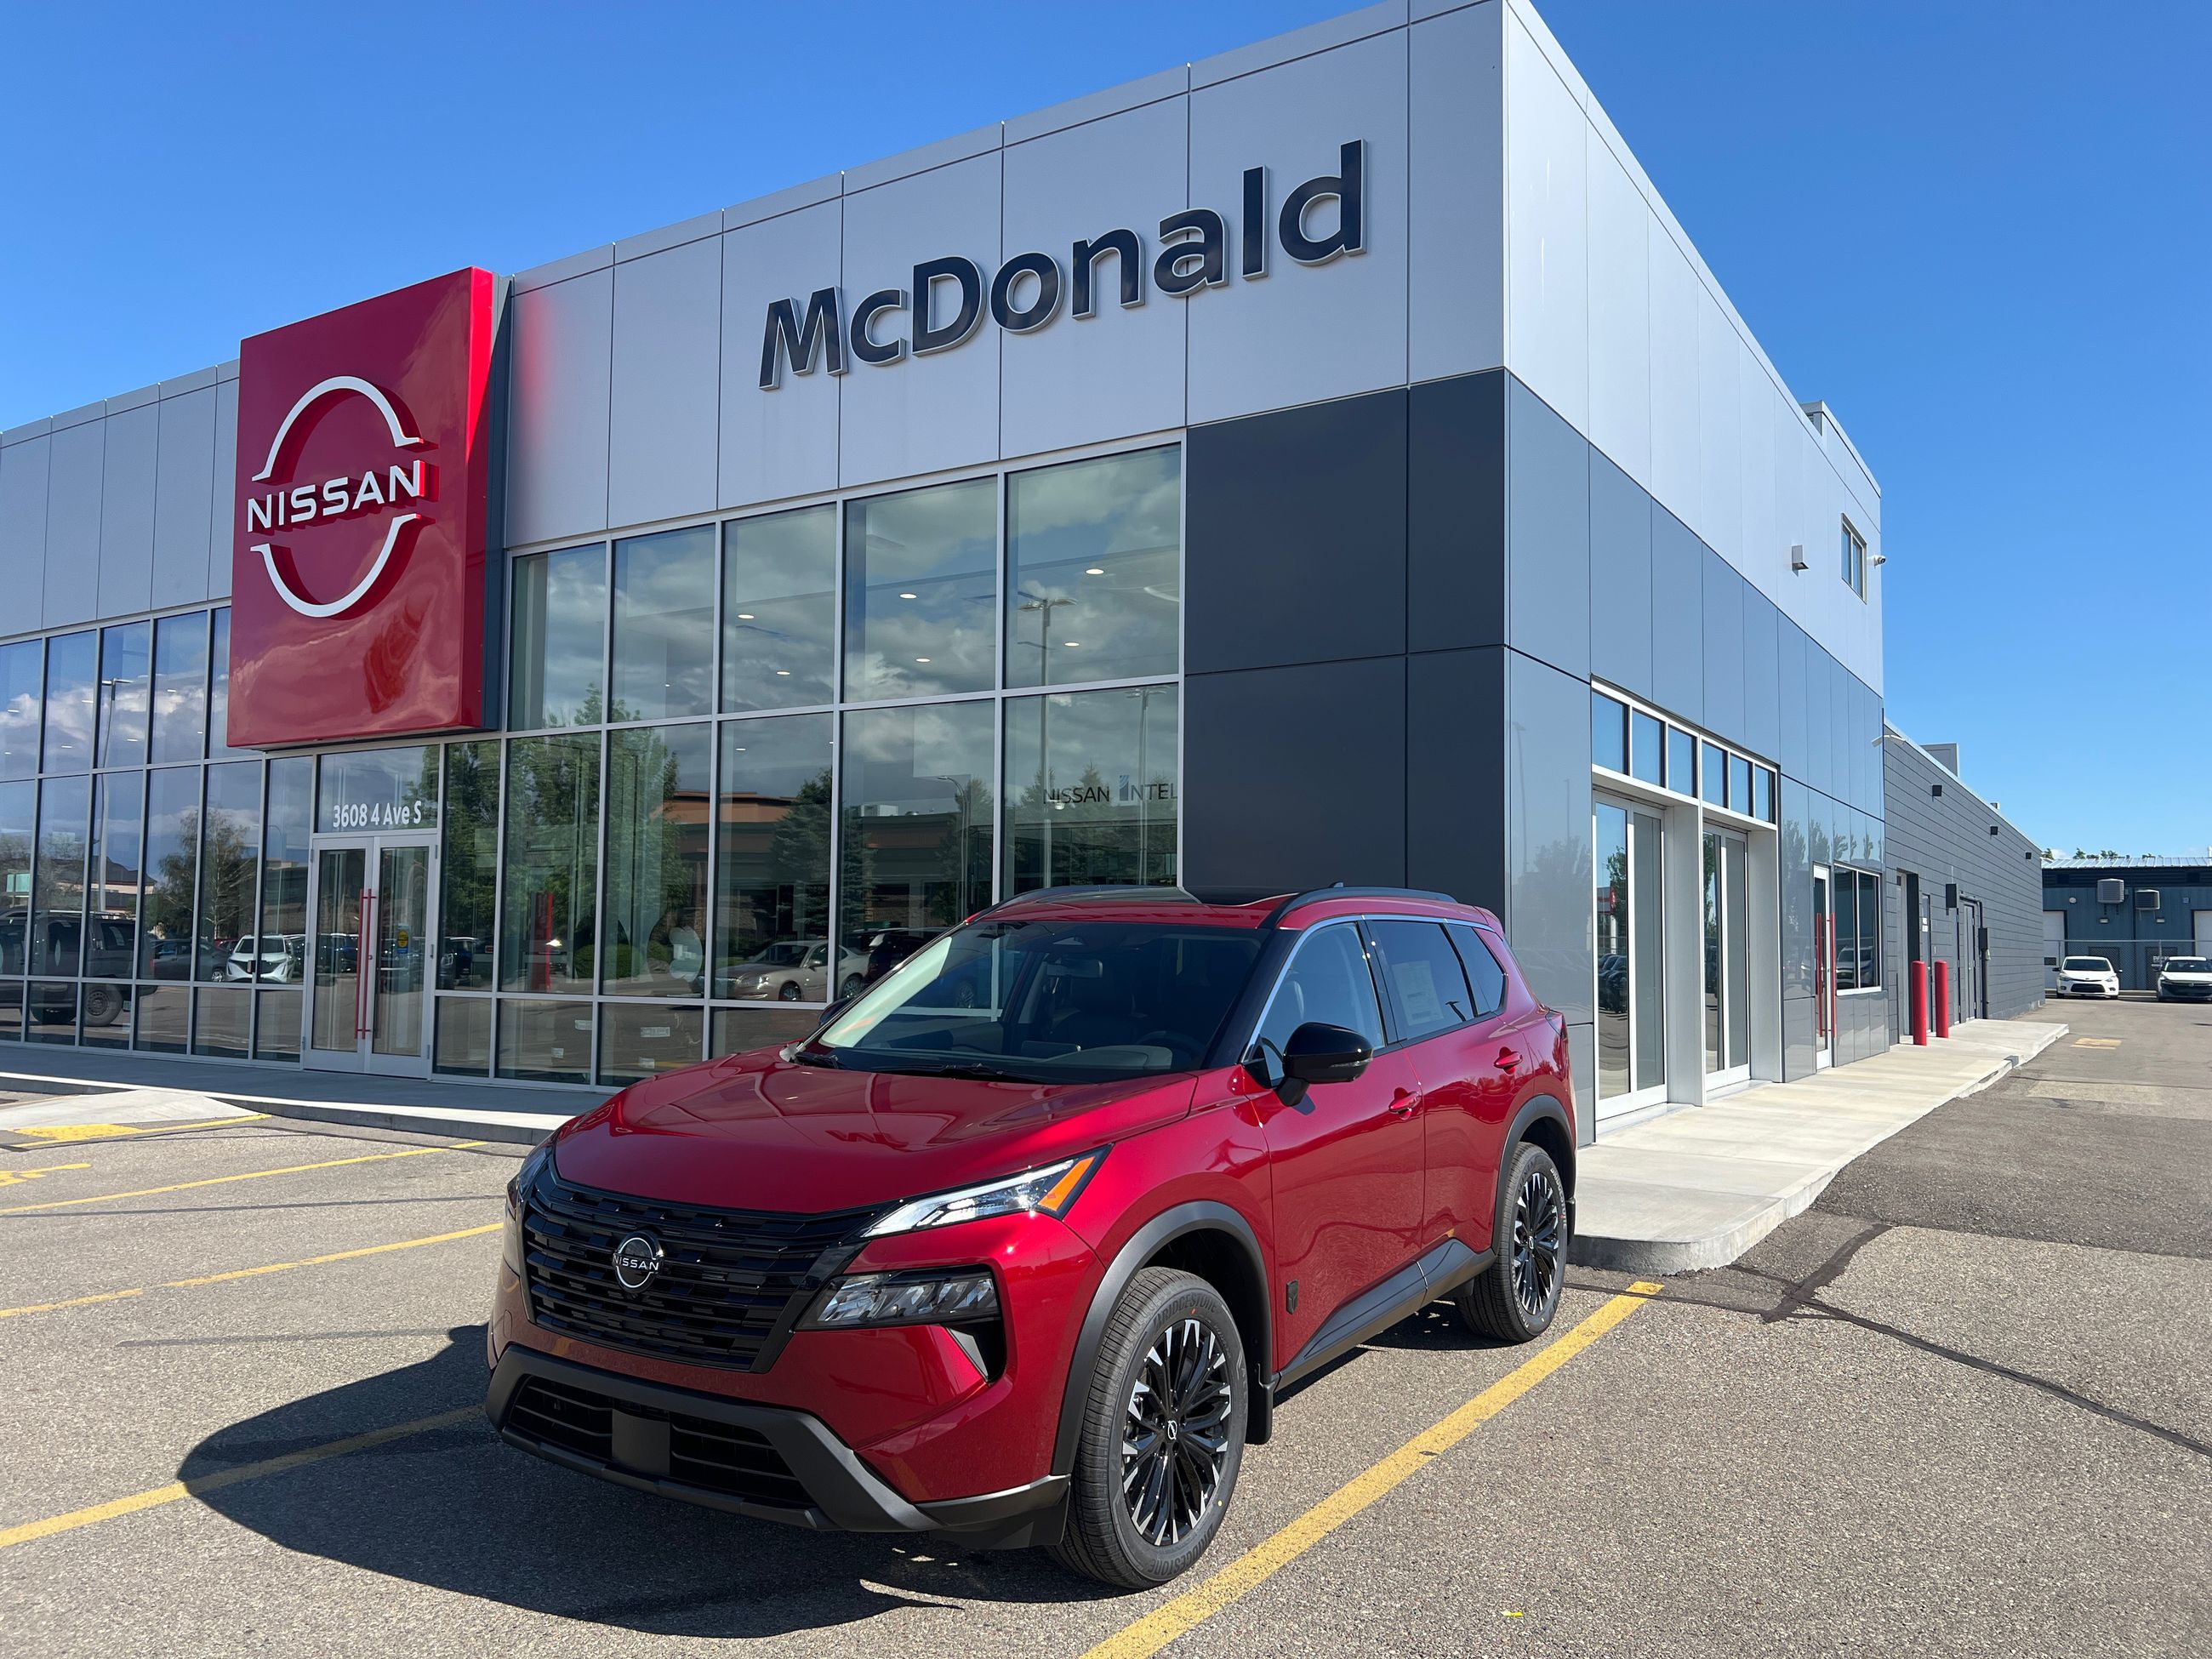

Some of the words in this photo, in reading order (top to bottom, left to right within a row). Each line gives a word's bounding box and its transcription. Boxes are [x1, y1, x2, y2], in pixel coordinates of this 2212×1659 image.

[759, 139, 1367, 391] McDonald
[248, 459, 425, 532] NISSAN
[1043, 786, 1109, 804] NISSAN
[333, 804, 368, 827] 3608
[371, 803, 379, 825] 4
[383, 802, 410, 825] Ave
[413, 801, 422, 824] S
[613, 1253, 659, 1270] NISSAN
